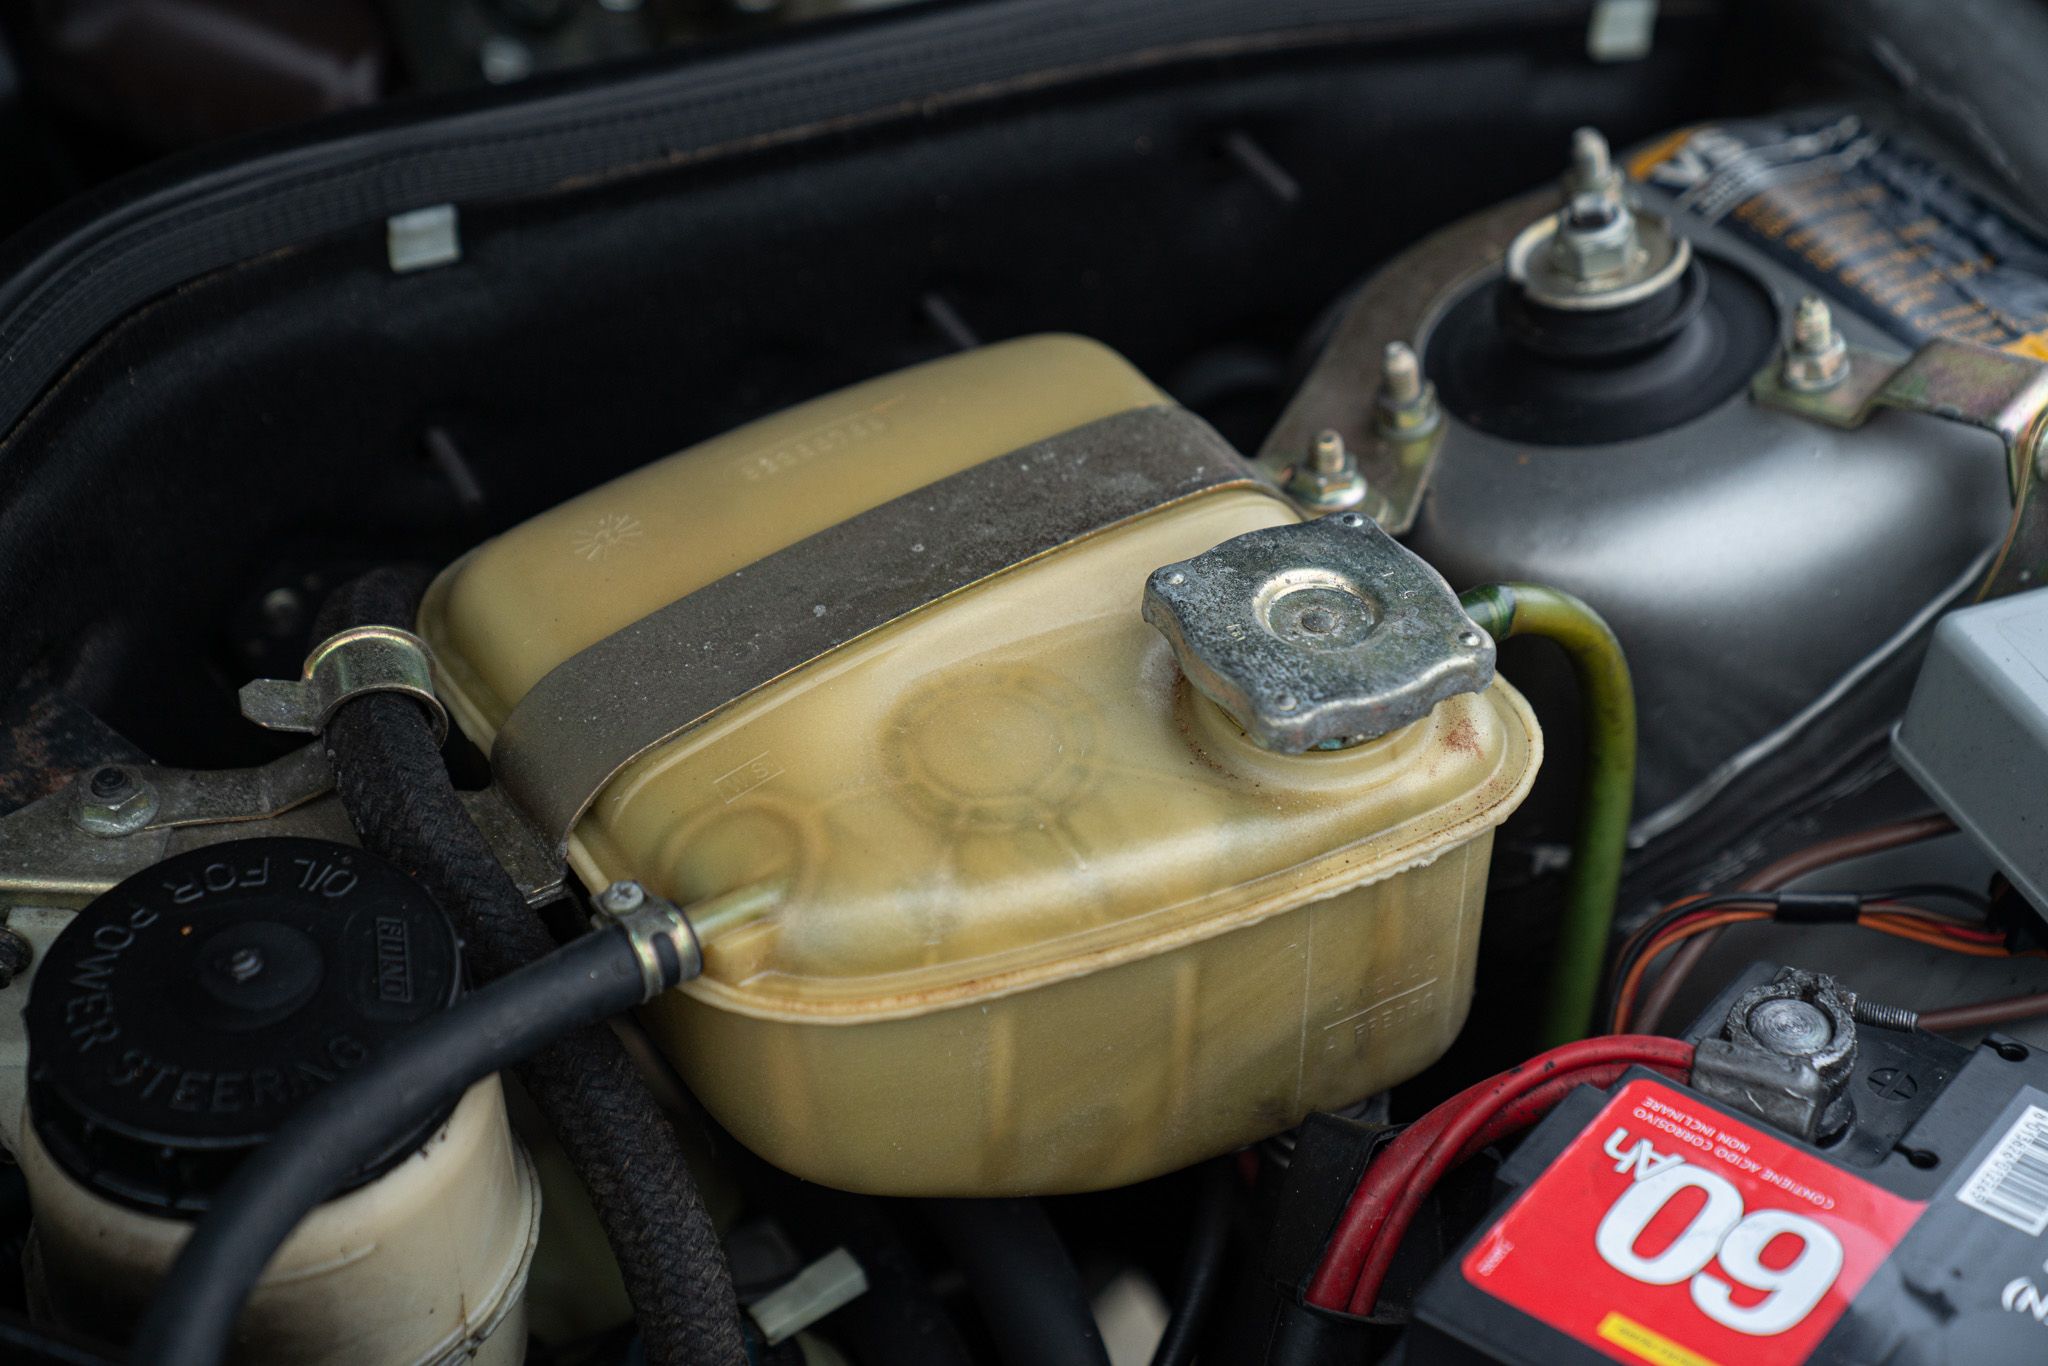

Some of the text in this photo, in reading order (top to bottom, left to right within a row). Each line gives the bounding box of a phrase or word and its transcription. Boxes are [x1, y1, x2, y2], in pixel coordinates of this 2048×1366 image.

[162, 857, 269, 904] FOR
[293, 858, 358, 897] OIL
[66, 906, 159, 1052] POWER
[1641, 1096, 1751, 1155] NON INCLINARE
[1633, 1107, 1836, 1210] CONTIENE ACIDO CORROSIVO
